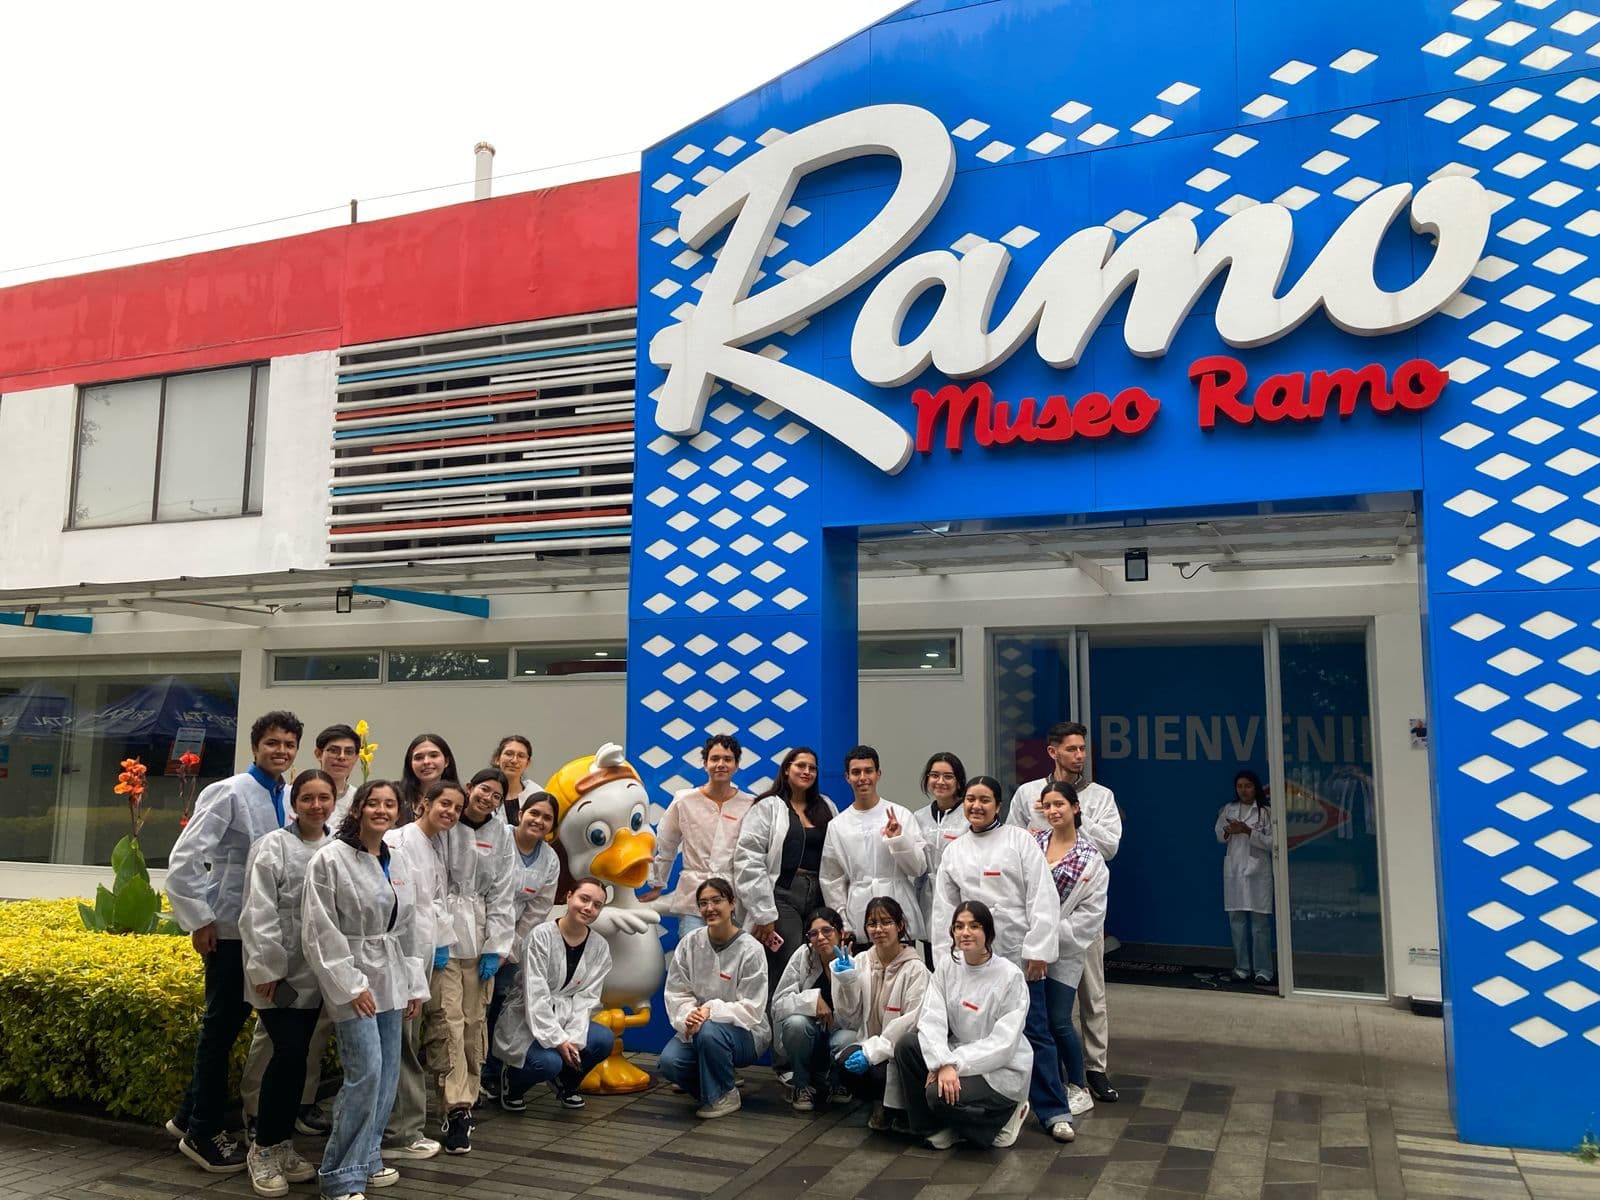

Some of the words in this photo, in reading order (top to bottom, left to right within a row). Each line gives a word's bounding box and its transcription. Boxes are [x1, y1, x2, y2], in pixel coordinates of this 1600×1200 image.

[649, 103, 1493, 476] Ramo
[911, 380, 1161, 454] Museo
[1188, 356, 1449, 430] Ramo
[1099, 715, 1372, 763] BIENVENI
